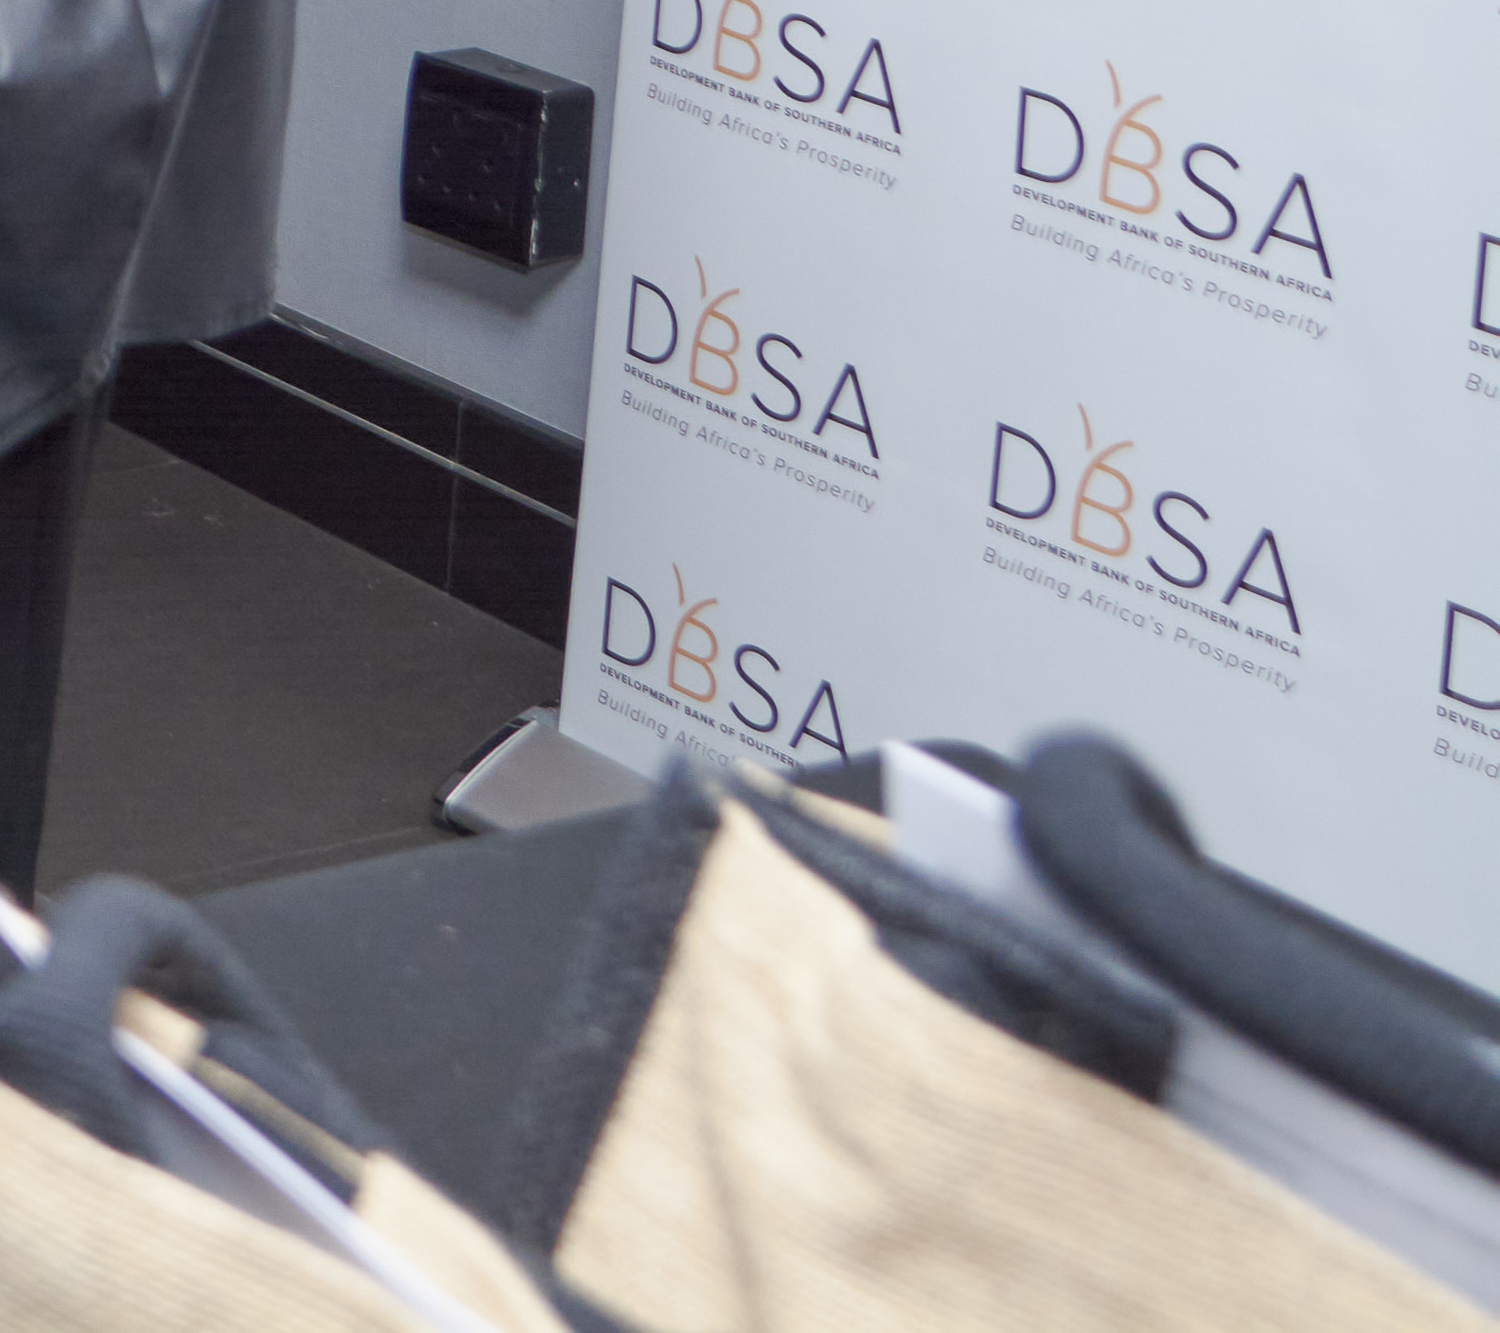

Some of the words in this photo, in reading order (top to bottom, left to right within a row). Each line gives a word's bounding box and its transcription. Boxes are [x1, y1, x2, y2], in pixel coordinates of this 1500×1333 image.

[645, 82, 714, 128] Building
[716, 113, 790, 153] Africa's
[795, 139, 898, 192] Prosperity
[649, 54, 726, 93] DEVELOPMENT
[727, 86, 761, 108] BANK
[763, 99, 781, 113] OF
[783, 106, 853, 140] SOUTHERN
[855, 130, 903, 157] AFRICA
[1013, 58, 1334, 280] DBSA
[1009, 213, 1101, 263] Building
[1105, 248, 1196, 294] Africa's
[1201, 280, 1329, 342] Prosperity
[1012, 183, 1116, 227] DEVELOPMENT
[1119, 220, 1160, 244] BANK
[1163, 235, 1184, 250] OF
[1188, 243, 1271, 282] SOUTHERN
[1275, 274, 1334, 303] AFRICA
[623, 362, 703, 406] DEVELOPMENT
[705, 399, 738, 423] BANK
[740, 415, 759, 429] OF
[760, 423, 829, 461] SOUTHERN
[831, 452, 881, 481] AFRICA
[625, 254, 881, 460] DBSA
[620, 388, 692, 438] Building
[694, 425, 767, 470] Africa's
[772, 456, 877, 515] Prosperity
[987, 401, 1303, 636] DBSA
[981, 545, 1072, 601] Building
[1077, 588, 1165, 638] Africa's
[1172, 626, 1298, 693] Prosperity
[985, 516, 1088, 567] DEVELOPMENT
[1090, 560, 1131, 587] BANK
[1134, 579, 1156, 595] OF
[1158, 588, 1240, 633] SOUTHERN
[1243, 625, 1302, 659] AFRICA
[600, 561, 848, 765] DBSA
